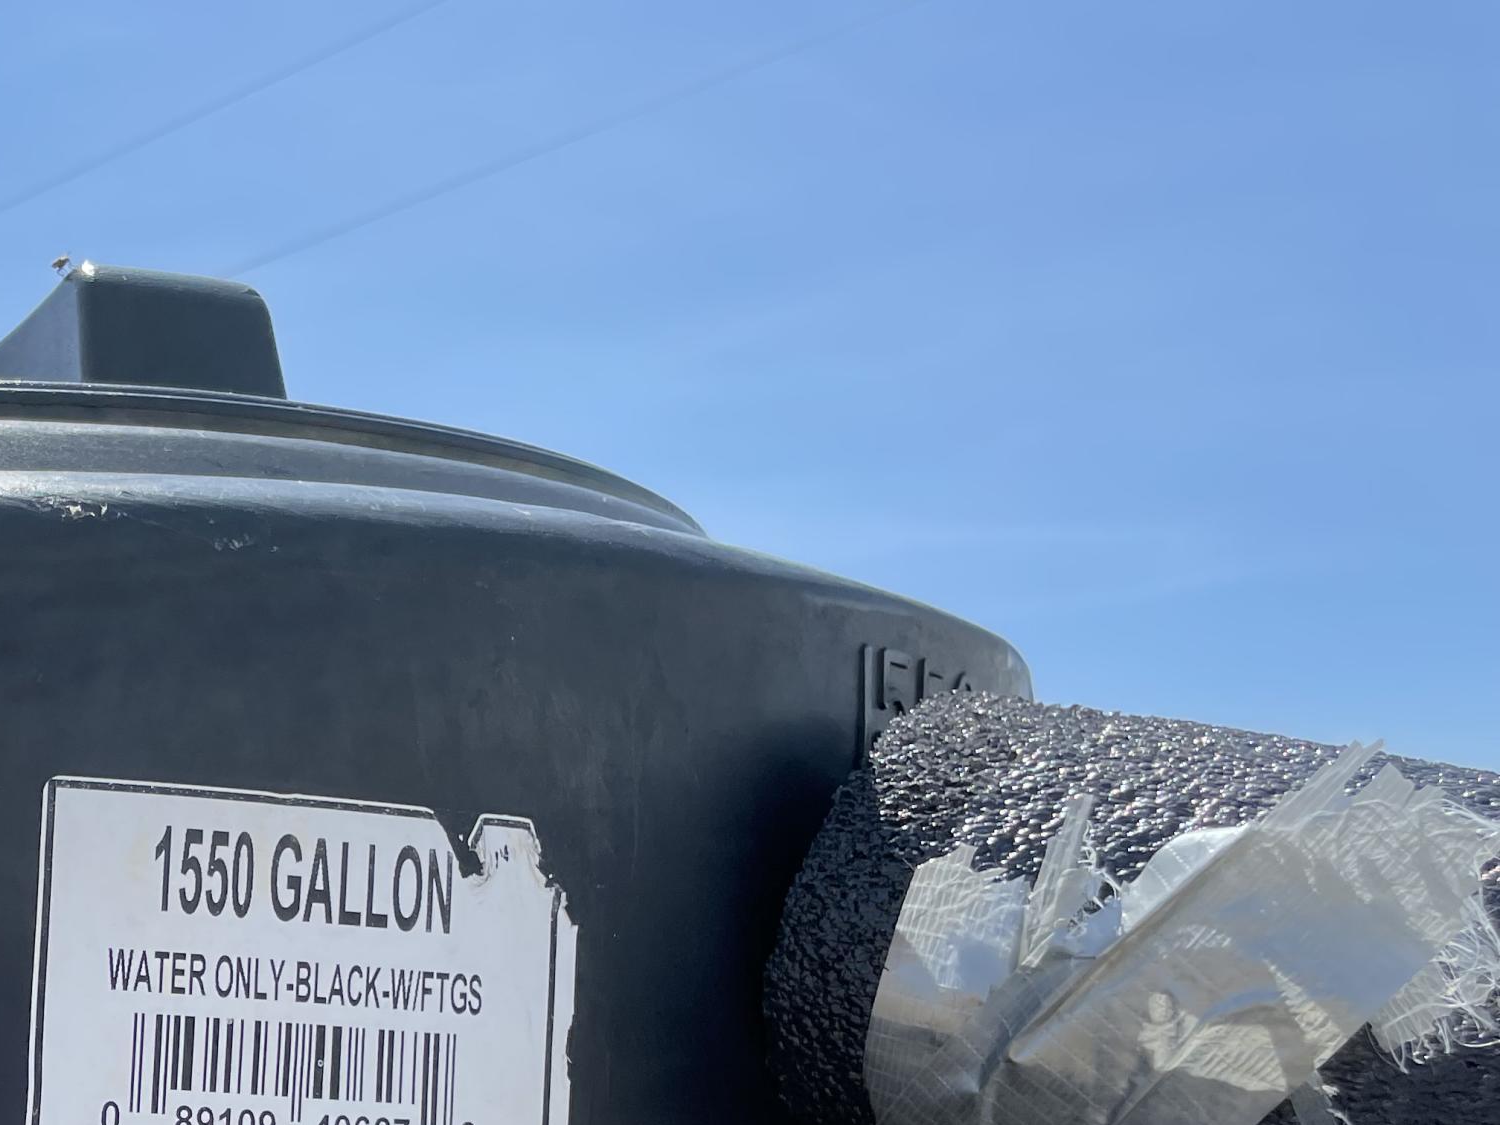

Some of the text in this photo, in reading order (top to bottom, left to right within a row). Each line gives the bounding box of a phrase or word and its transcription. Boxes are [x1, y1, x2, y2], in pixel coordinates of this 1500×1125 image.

[154, 824, 454, 934] 1550 GALLON
[108, 947, 483, 1016] WATER ONLY-BLACK-W/FTGS
